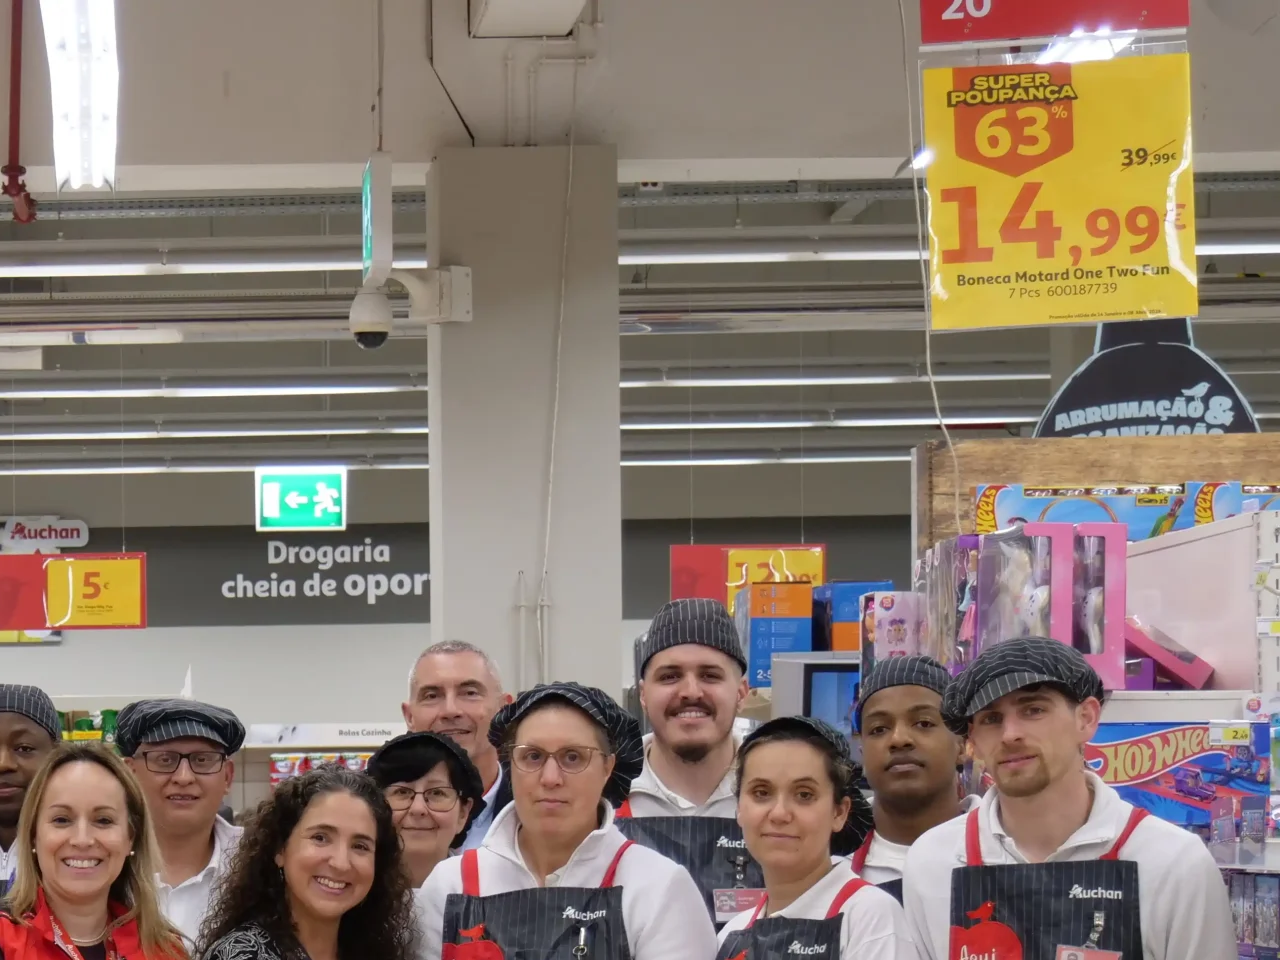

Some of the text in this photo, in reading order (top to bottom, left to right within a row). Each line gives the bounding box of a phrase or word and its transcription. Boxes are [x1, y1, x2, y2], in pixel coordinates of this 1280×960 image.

[973, 72, 1051, 91] SUPER
[950, 85, 1077, 106] POUPANÇA
[956, 263, 1170, 287] Boneca Motard One Two Fun
[1009, 282, 1118, 299] 7 Pcs 600187739
[1054, 397, 1205, 432] ARRUMAÇÃO
[9, 521, 81, 541] Auchan
[267, 537, 391, 570] Drogaria
[221, 572, 431, 604] cheia de opor
[716, 835, 748, 849] Auch
[1068, 884, 1123, 900] Auchan
[562, 905, 607, 921] Auchan
[788, 940, 827, 955] Aucha
